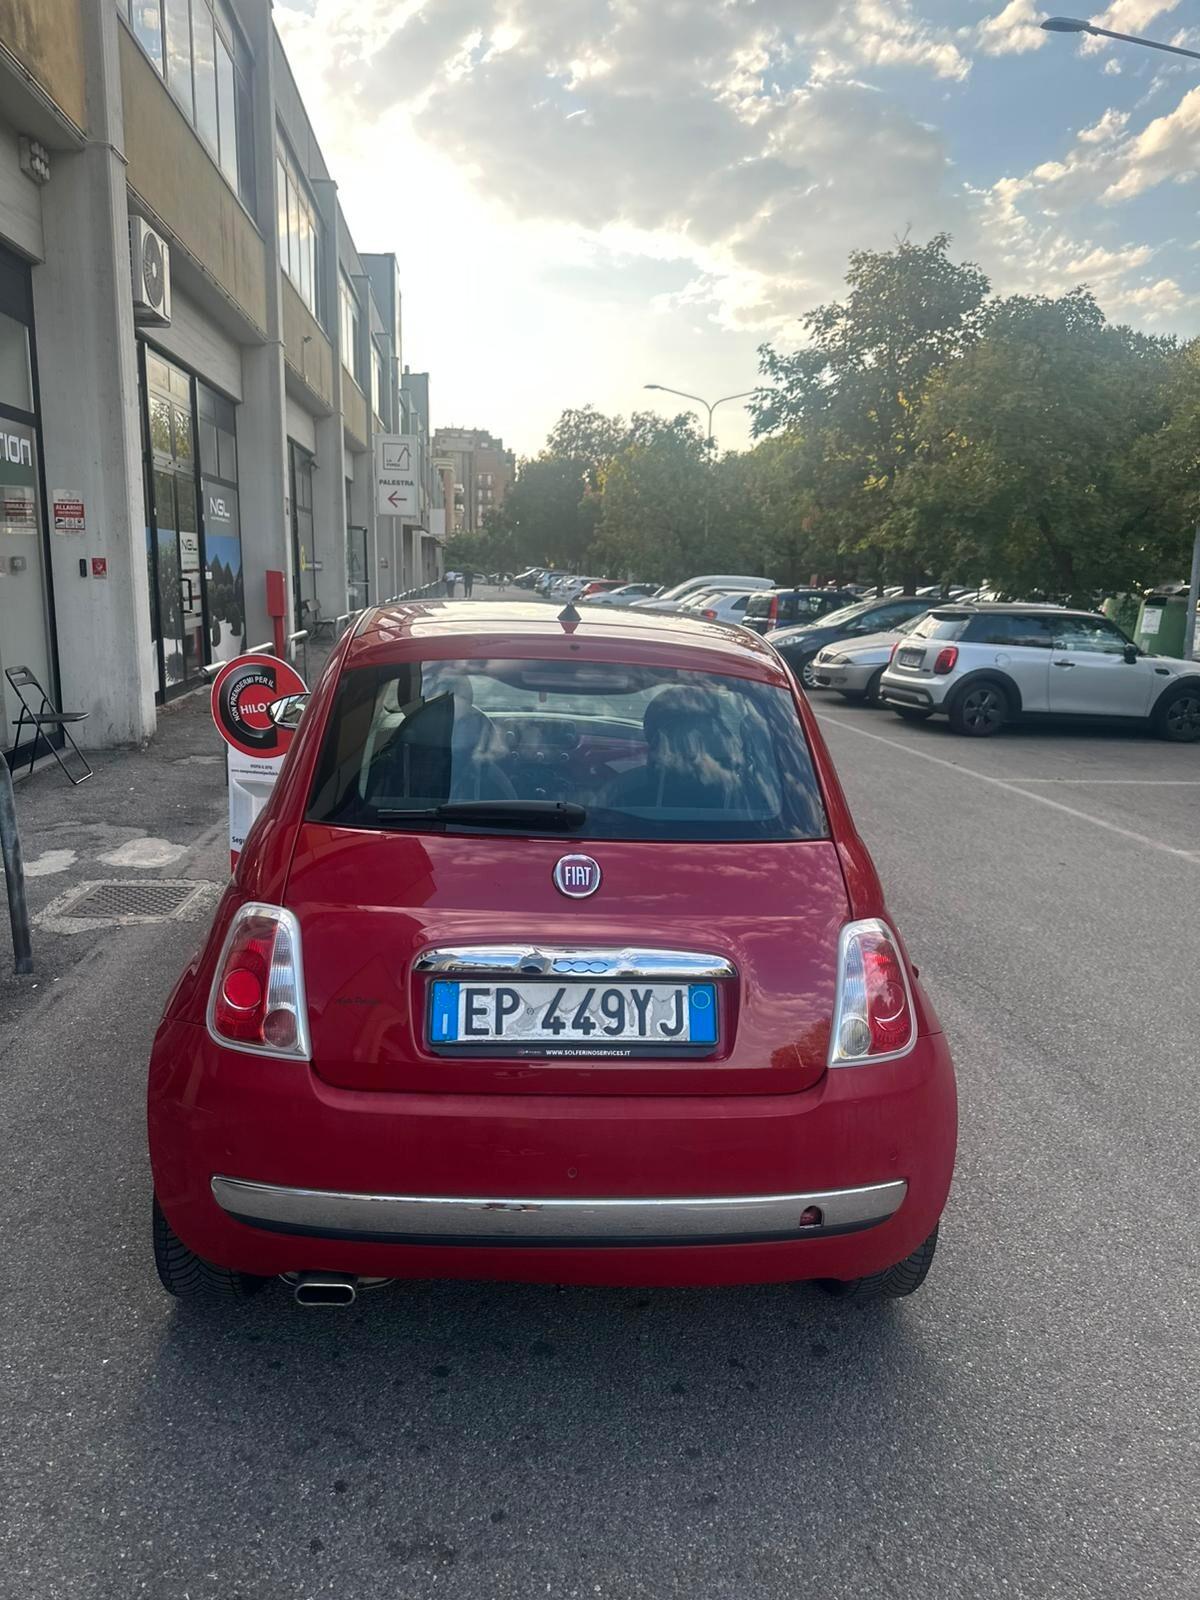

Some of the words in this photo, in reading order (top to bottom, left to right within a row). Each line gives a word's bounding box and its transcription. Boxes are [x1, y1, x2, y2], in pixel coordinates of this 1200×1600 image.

[0, 432, 32, 466] ION
[209, 498, 230, 517] NGL
[255, 675, 268, 684] PER
[268, 680, 274, 688] IL
[230, 676, 254, 706] PRENDERMI
[230, 706, 241, 722] NON
[565, 866, 591, 886] FIAT
[465, 987, 519, 1036] EP
[541, 988, 684, 1037] 449YJ
